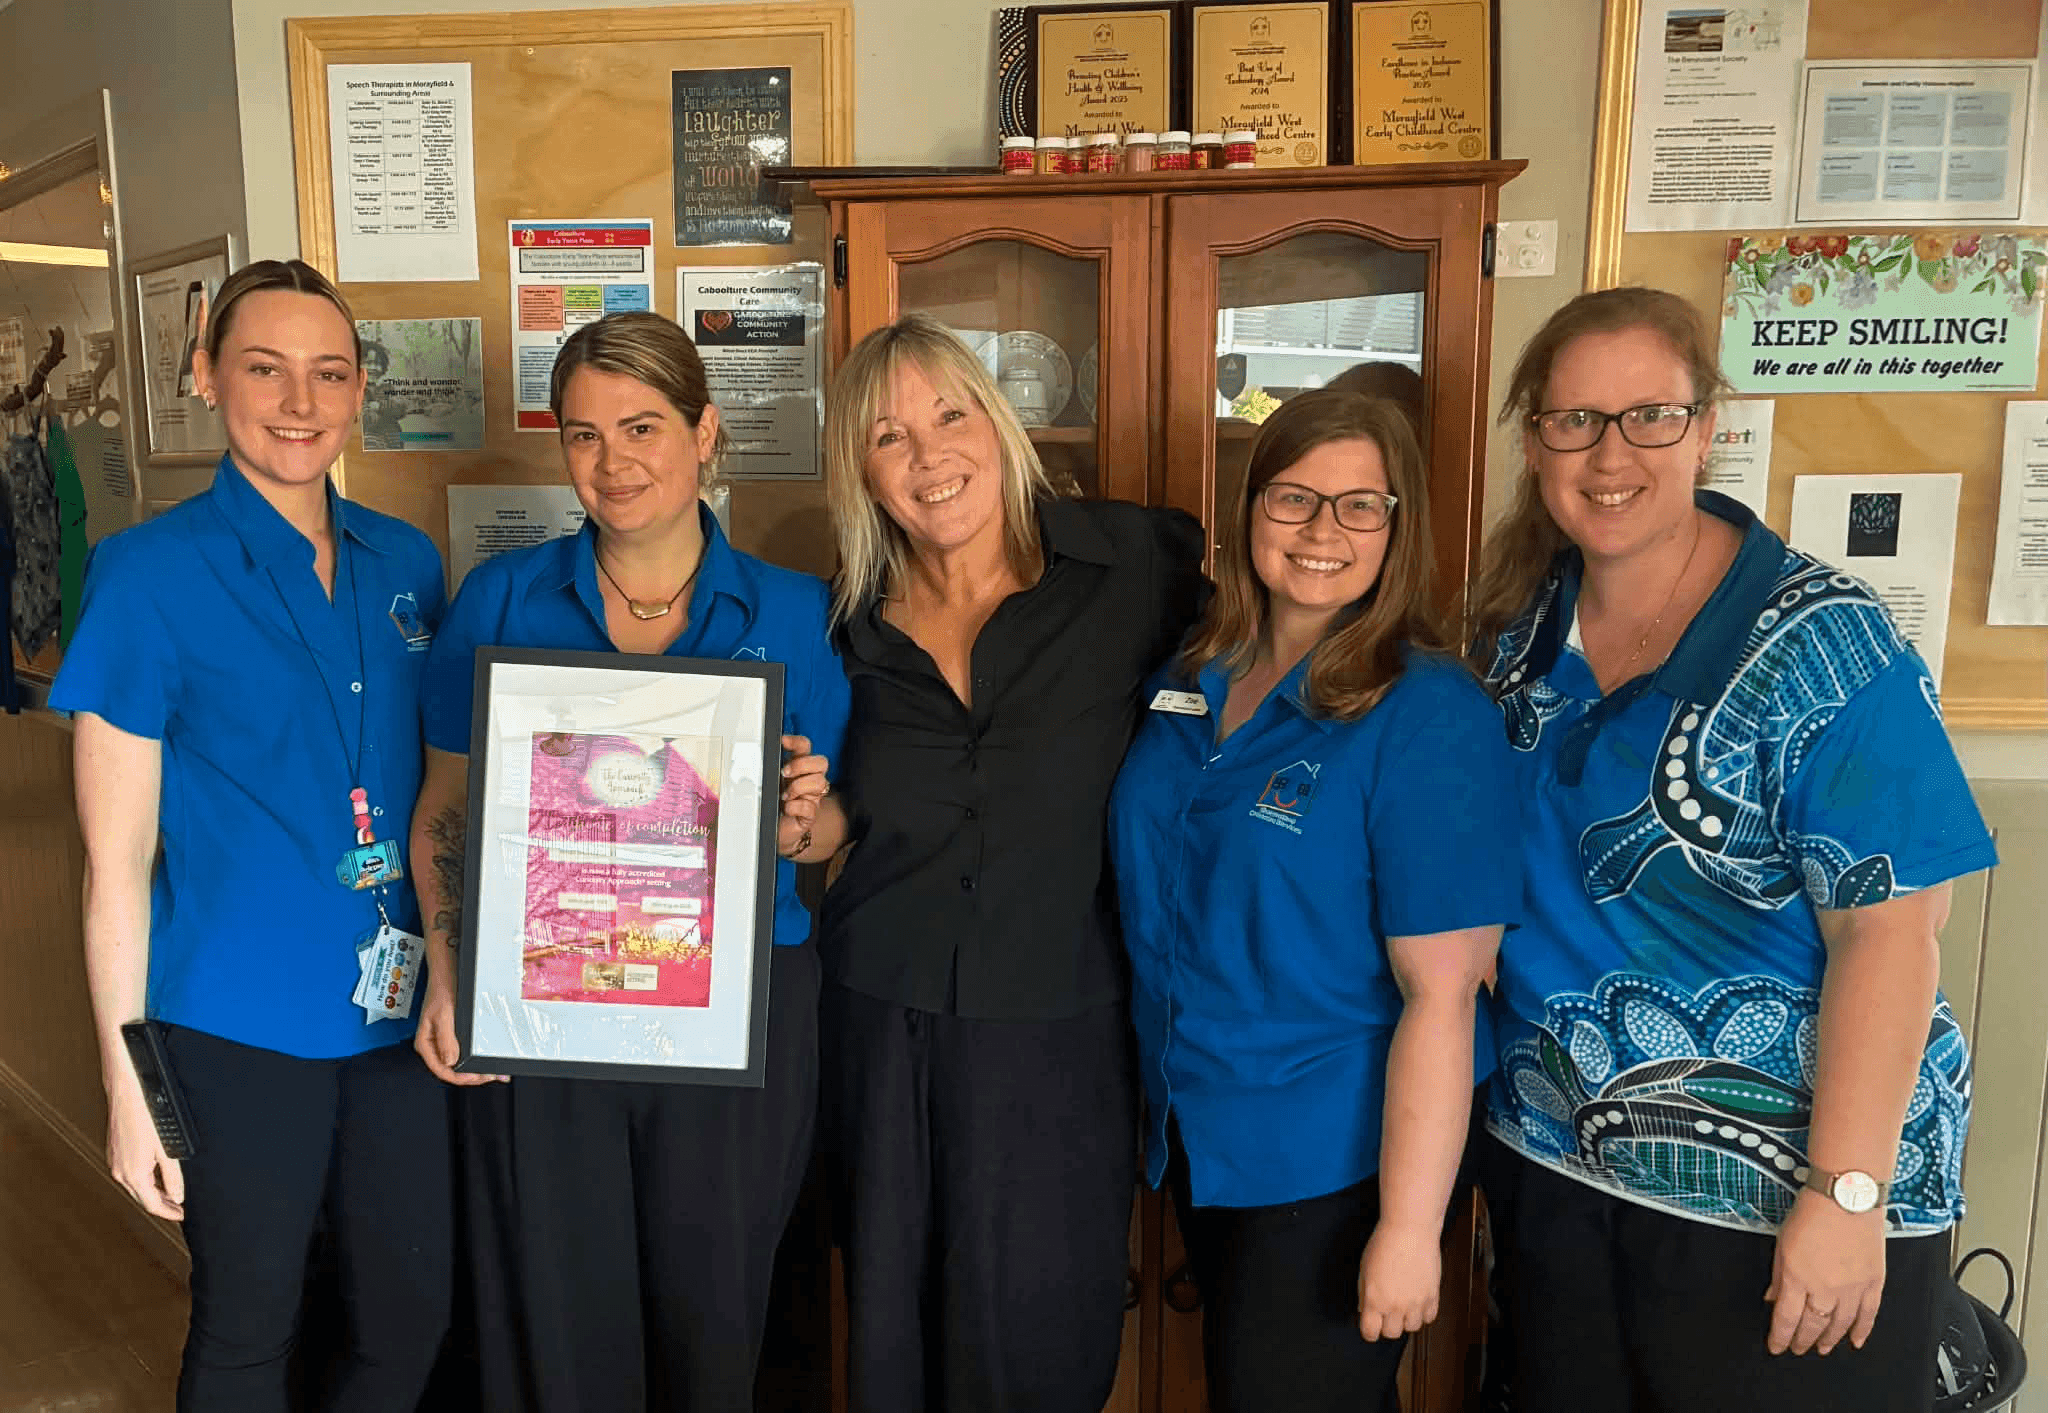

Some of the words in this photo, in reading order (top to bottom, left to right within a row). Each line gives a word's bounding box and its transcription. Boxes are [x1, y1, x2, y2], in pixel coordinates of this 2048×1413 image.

[1238, 62, 1255, 73] Best
[346, 81, 369, 90] Speech
[371, 81, 404, 89] Therapists
[413, 80, 448, 89] Morayfield
[1225, 73, 1264, 86] Technology
[371, 90, 411, 98] Surrounding
[1065, 82, 1093, 96] Health
[1221, 115, 1273, 131] Morayfield
[1278, 113, 1302, 126] West
[1383, 109, 1436, 125] Morayfield
[1440, 107, 1465, 120] West
[684, 111, 781, 137] Laughter
[1366, 123, 1393, 140] Early
[1396, 122, 1445, 136] Childhood
[1448, 121, 1482, 135] Centre
[1284, 127, 1316, 139] Centre
[698, 286, 748, 294] Caboolture
[750, 286, 803, 296] Community
[739, 297, 760, 305] Care
[1751, 319, 1839, 347] KEEP
[1849, 317, 2009, 346] SMILING!
[1753, 358, 1780, 376] We
[1785, 362, 1818, 375] are
[1823, 357, 1852, 375] all
[1854, 358, 1873, 375] in
[1879, 357, 1916, 375] this
[1921, 356, 2003, 379] together
[384, 388, 415, 396] wonder
[416, 388, 432, 396] and
[637, 818, 711, 837] completion
